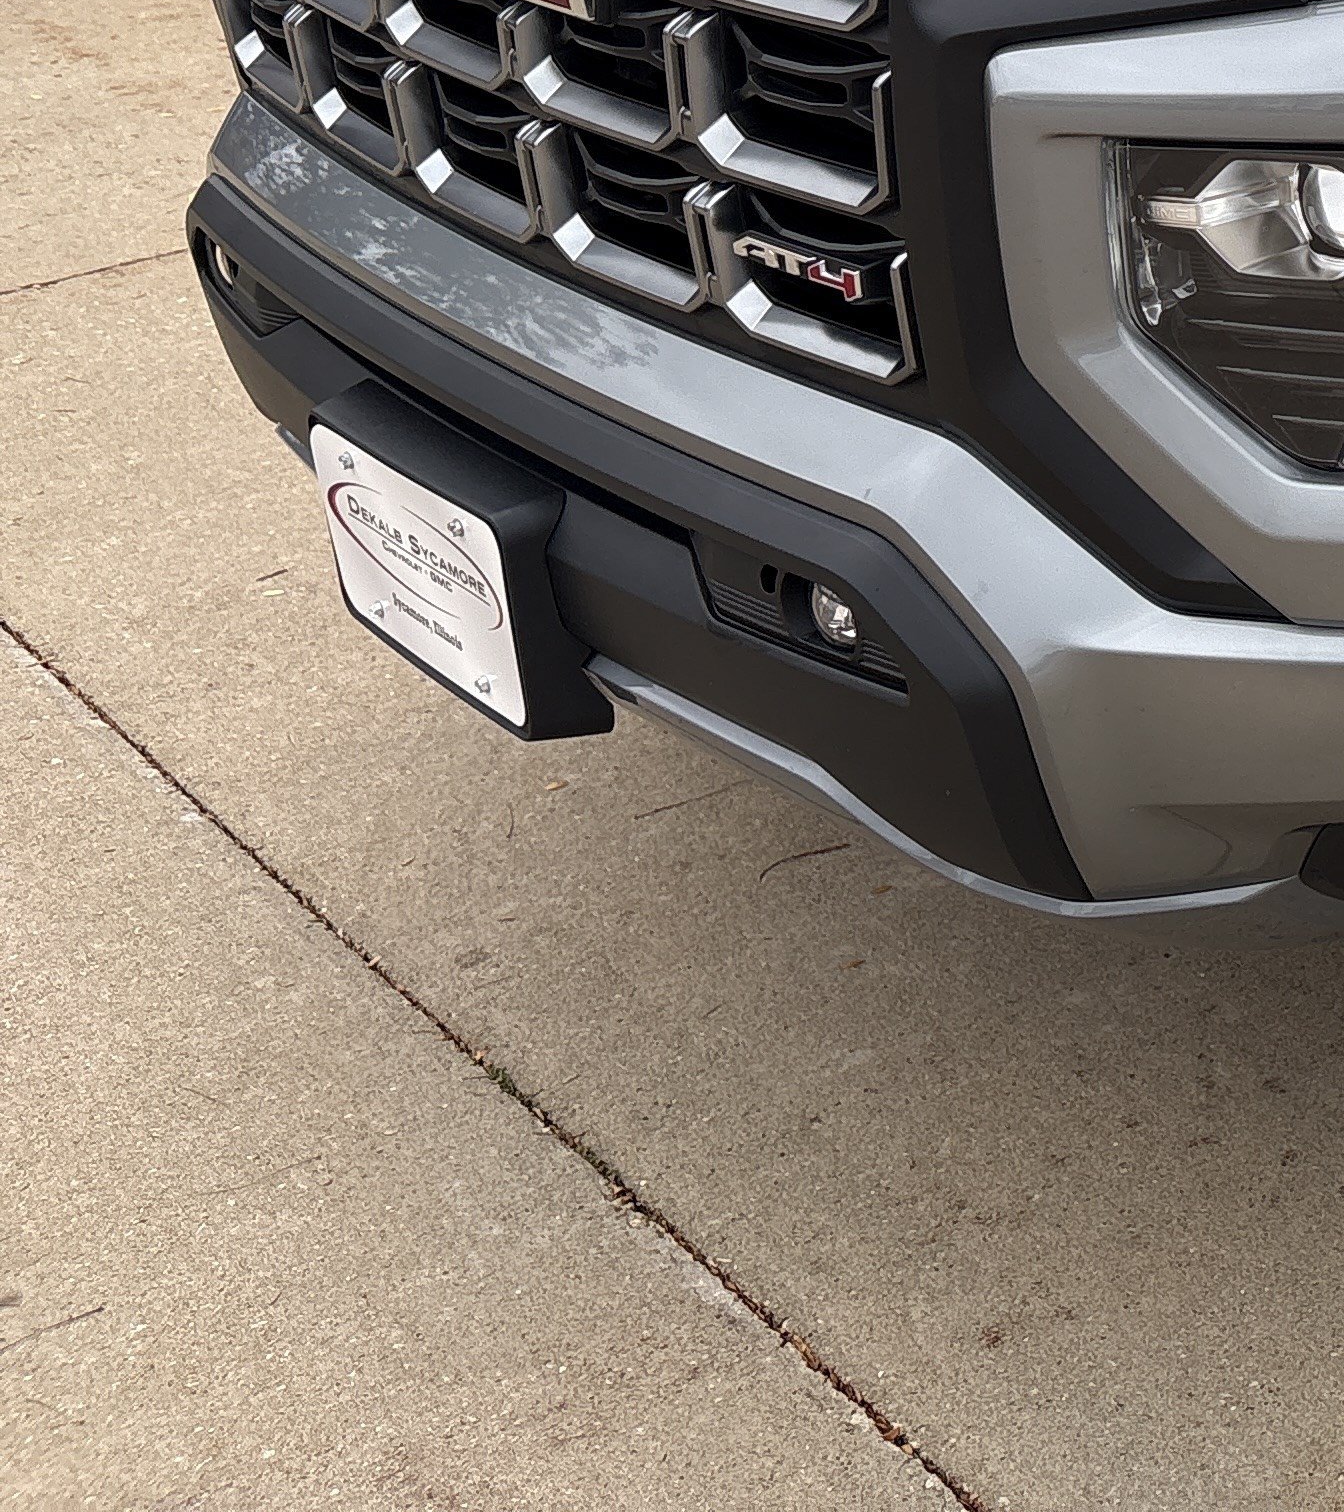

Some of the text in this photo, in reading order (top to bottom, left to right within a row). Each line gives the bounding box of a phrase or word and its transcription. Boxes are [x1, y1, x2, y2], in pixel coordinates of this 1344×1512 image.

[733, 235, 864, 302] AT4
[408, 534, 487, 598] SYCAMORE
[429, 571, 454, 593] GMC
